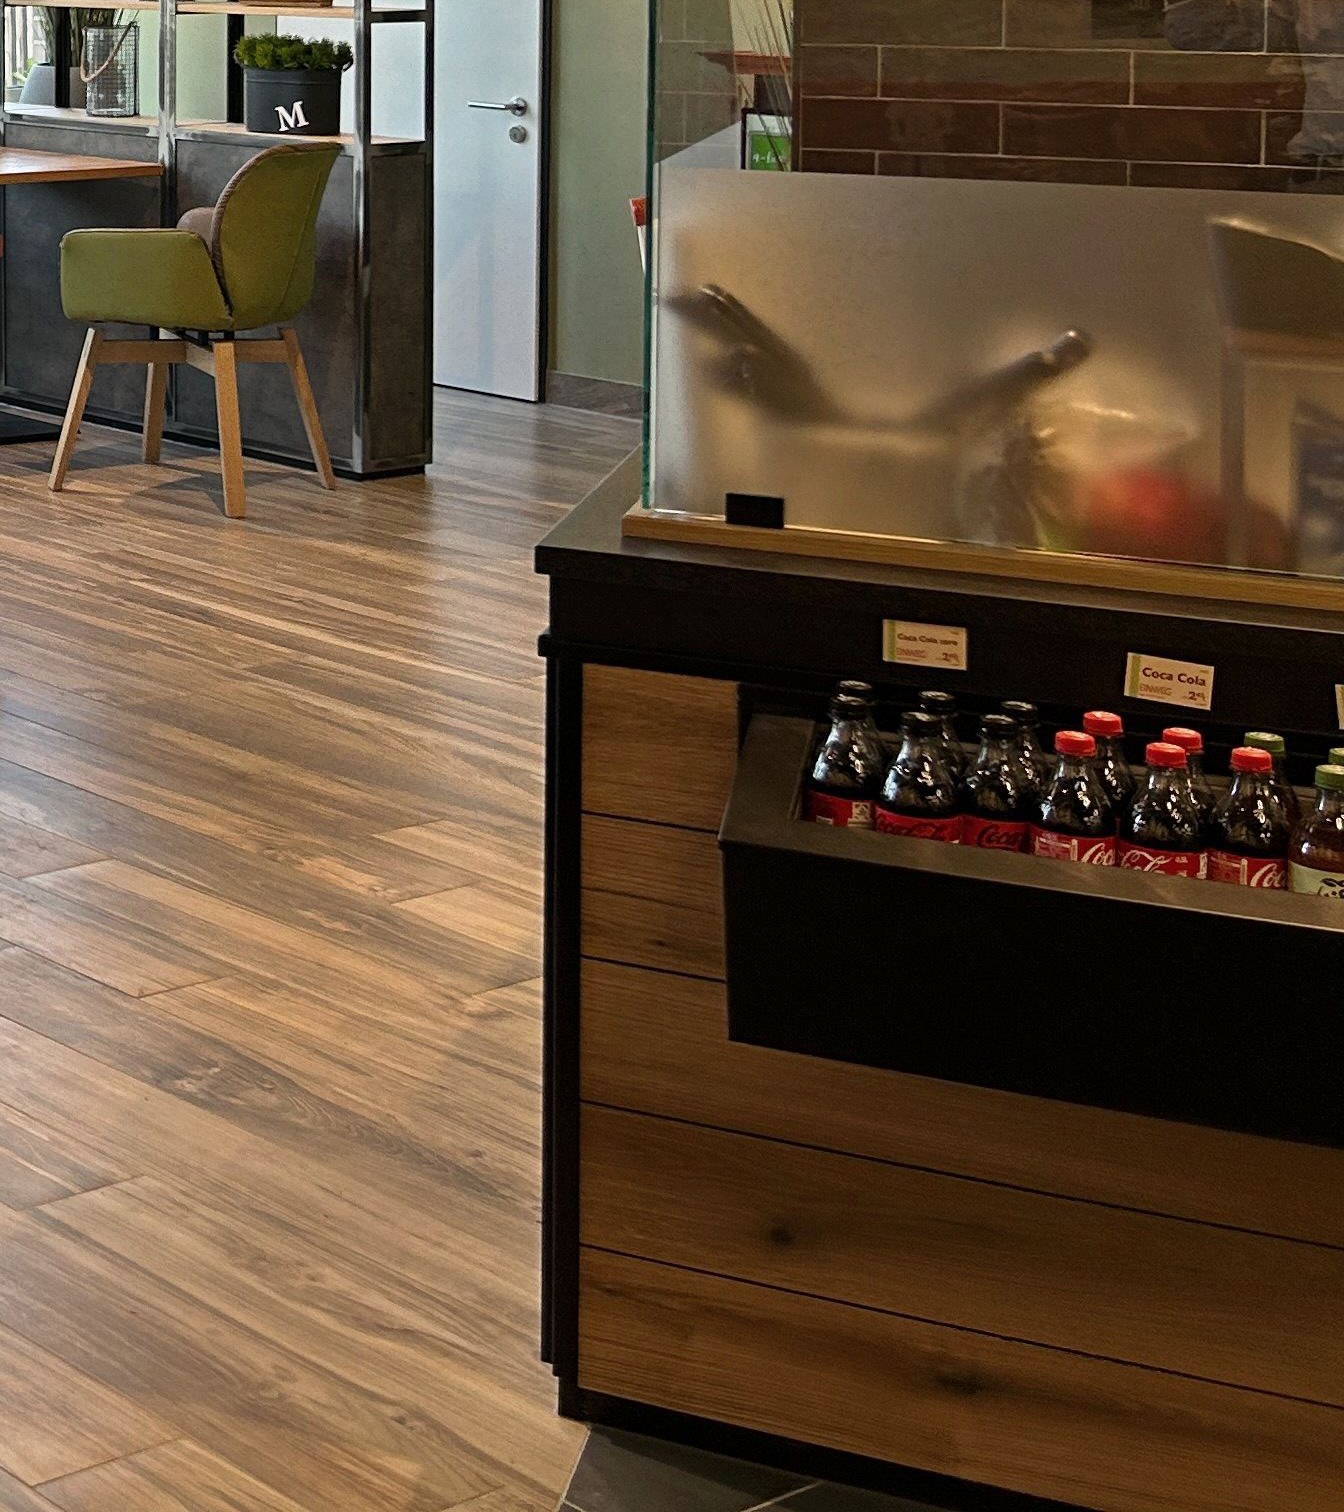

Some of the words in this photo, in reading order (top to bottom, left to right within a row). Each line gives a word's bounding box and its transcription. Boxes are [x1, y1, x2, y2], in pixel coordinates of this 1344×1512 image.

[274, 100, 310, 132] M
[897, 633, 917, 642] Coca
[918, 636, 938, 644] Cola
[1142, 667, 1173, 681] Coca
[1177, 673, 1207, 687] Cola
